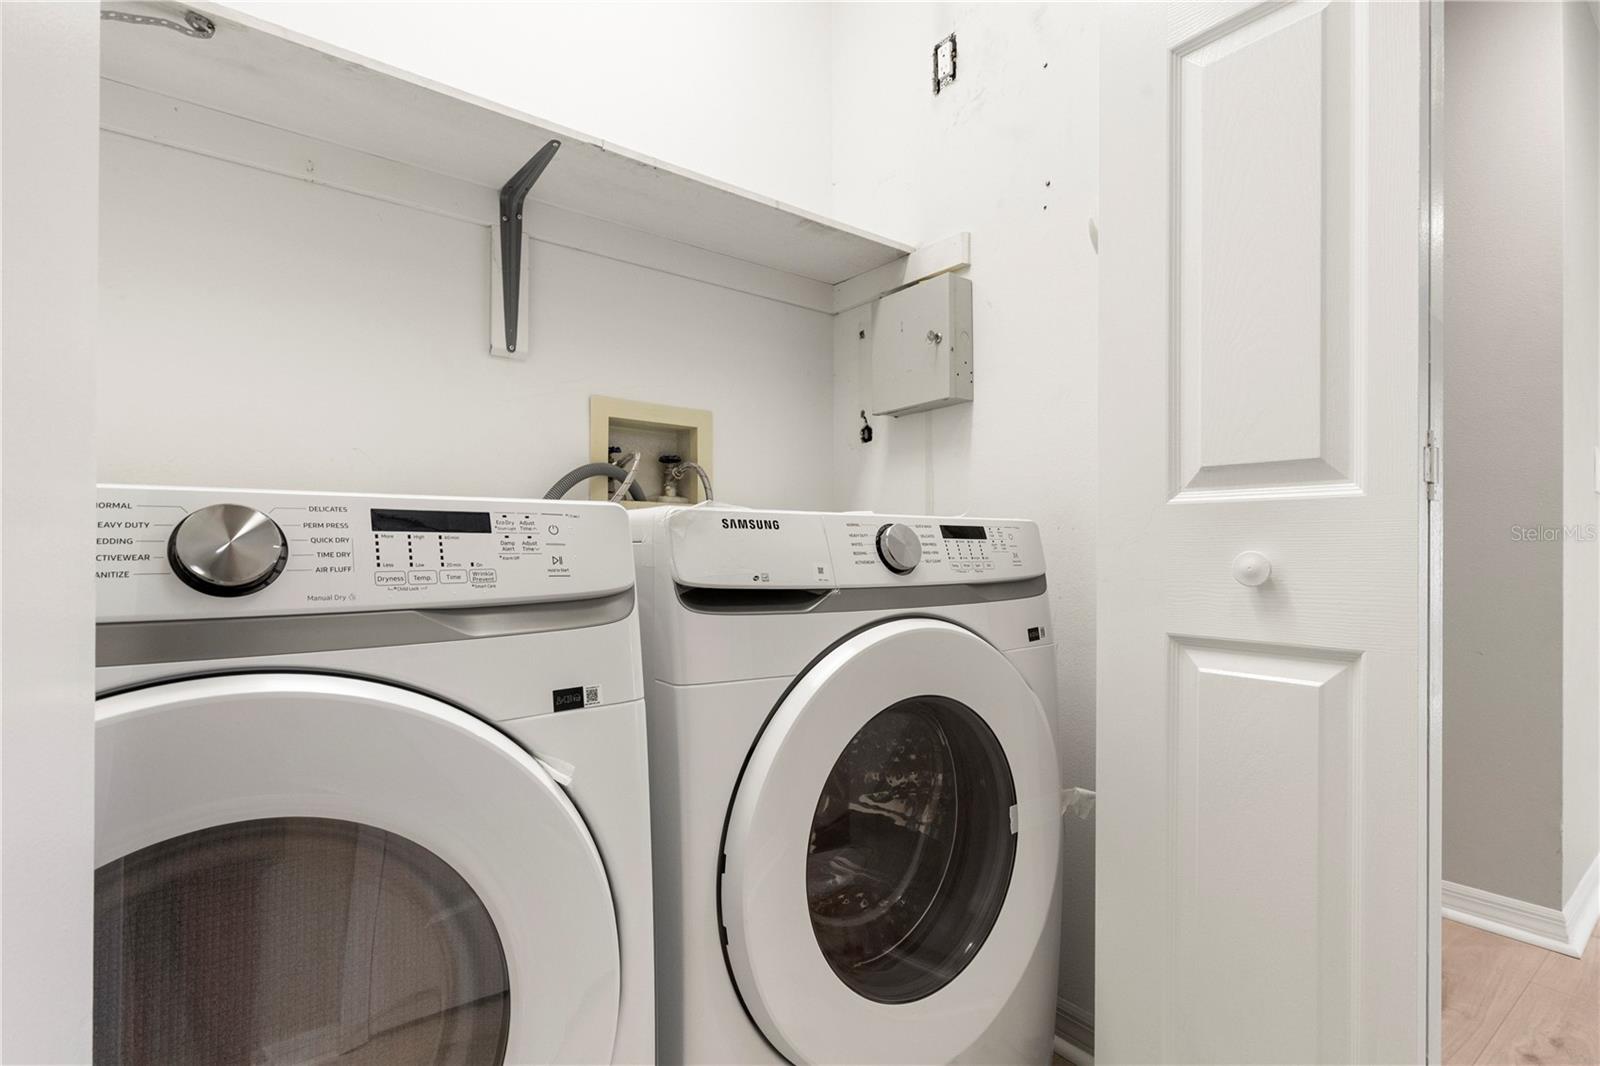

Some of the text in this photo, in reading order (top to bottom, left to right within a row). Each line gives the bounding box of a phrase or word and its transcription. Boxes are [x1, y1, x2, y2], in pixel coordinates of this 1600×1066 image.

[722, 518, 780, 530] SAMSUNG
[95, 554, 151, 562] CTIVEWEAR
[96, 570, 130, 578] ANITIZE
[414, 574, 432, 582] Temp.
[376, 575, 405, 583] Dryness
